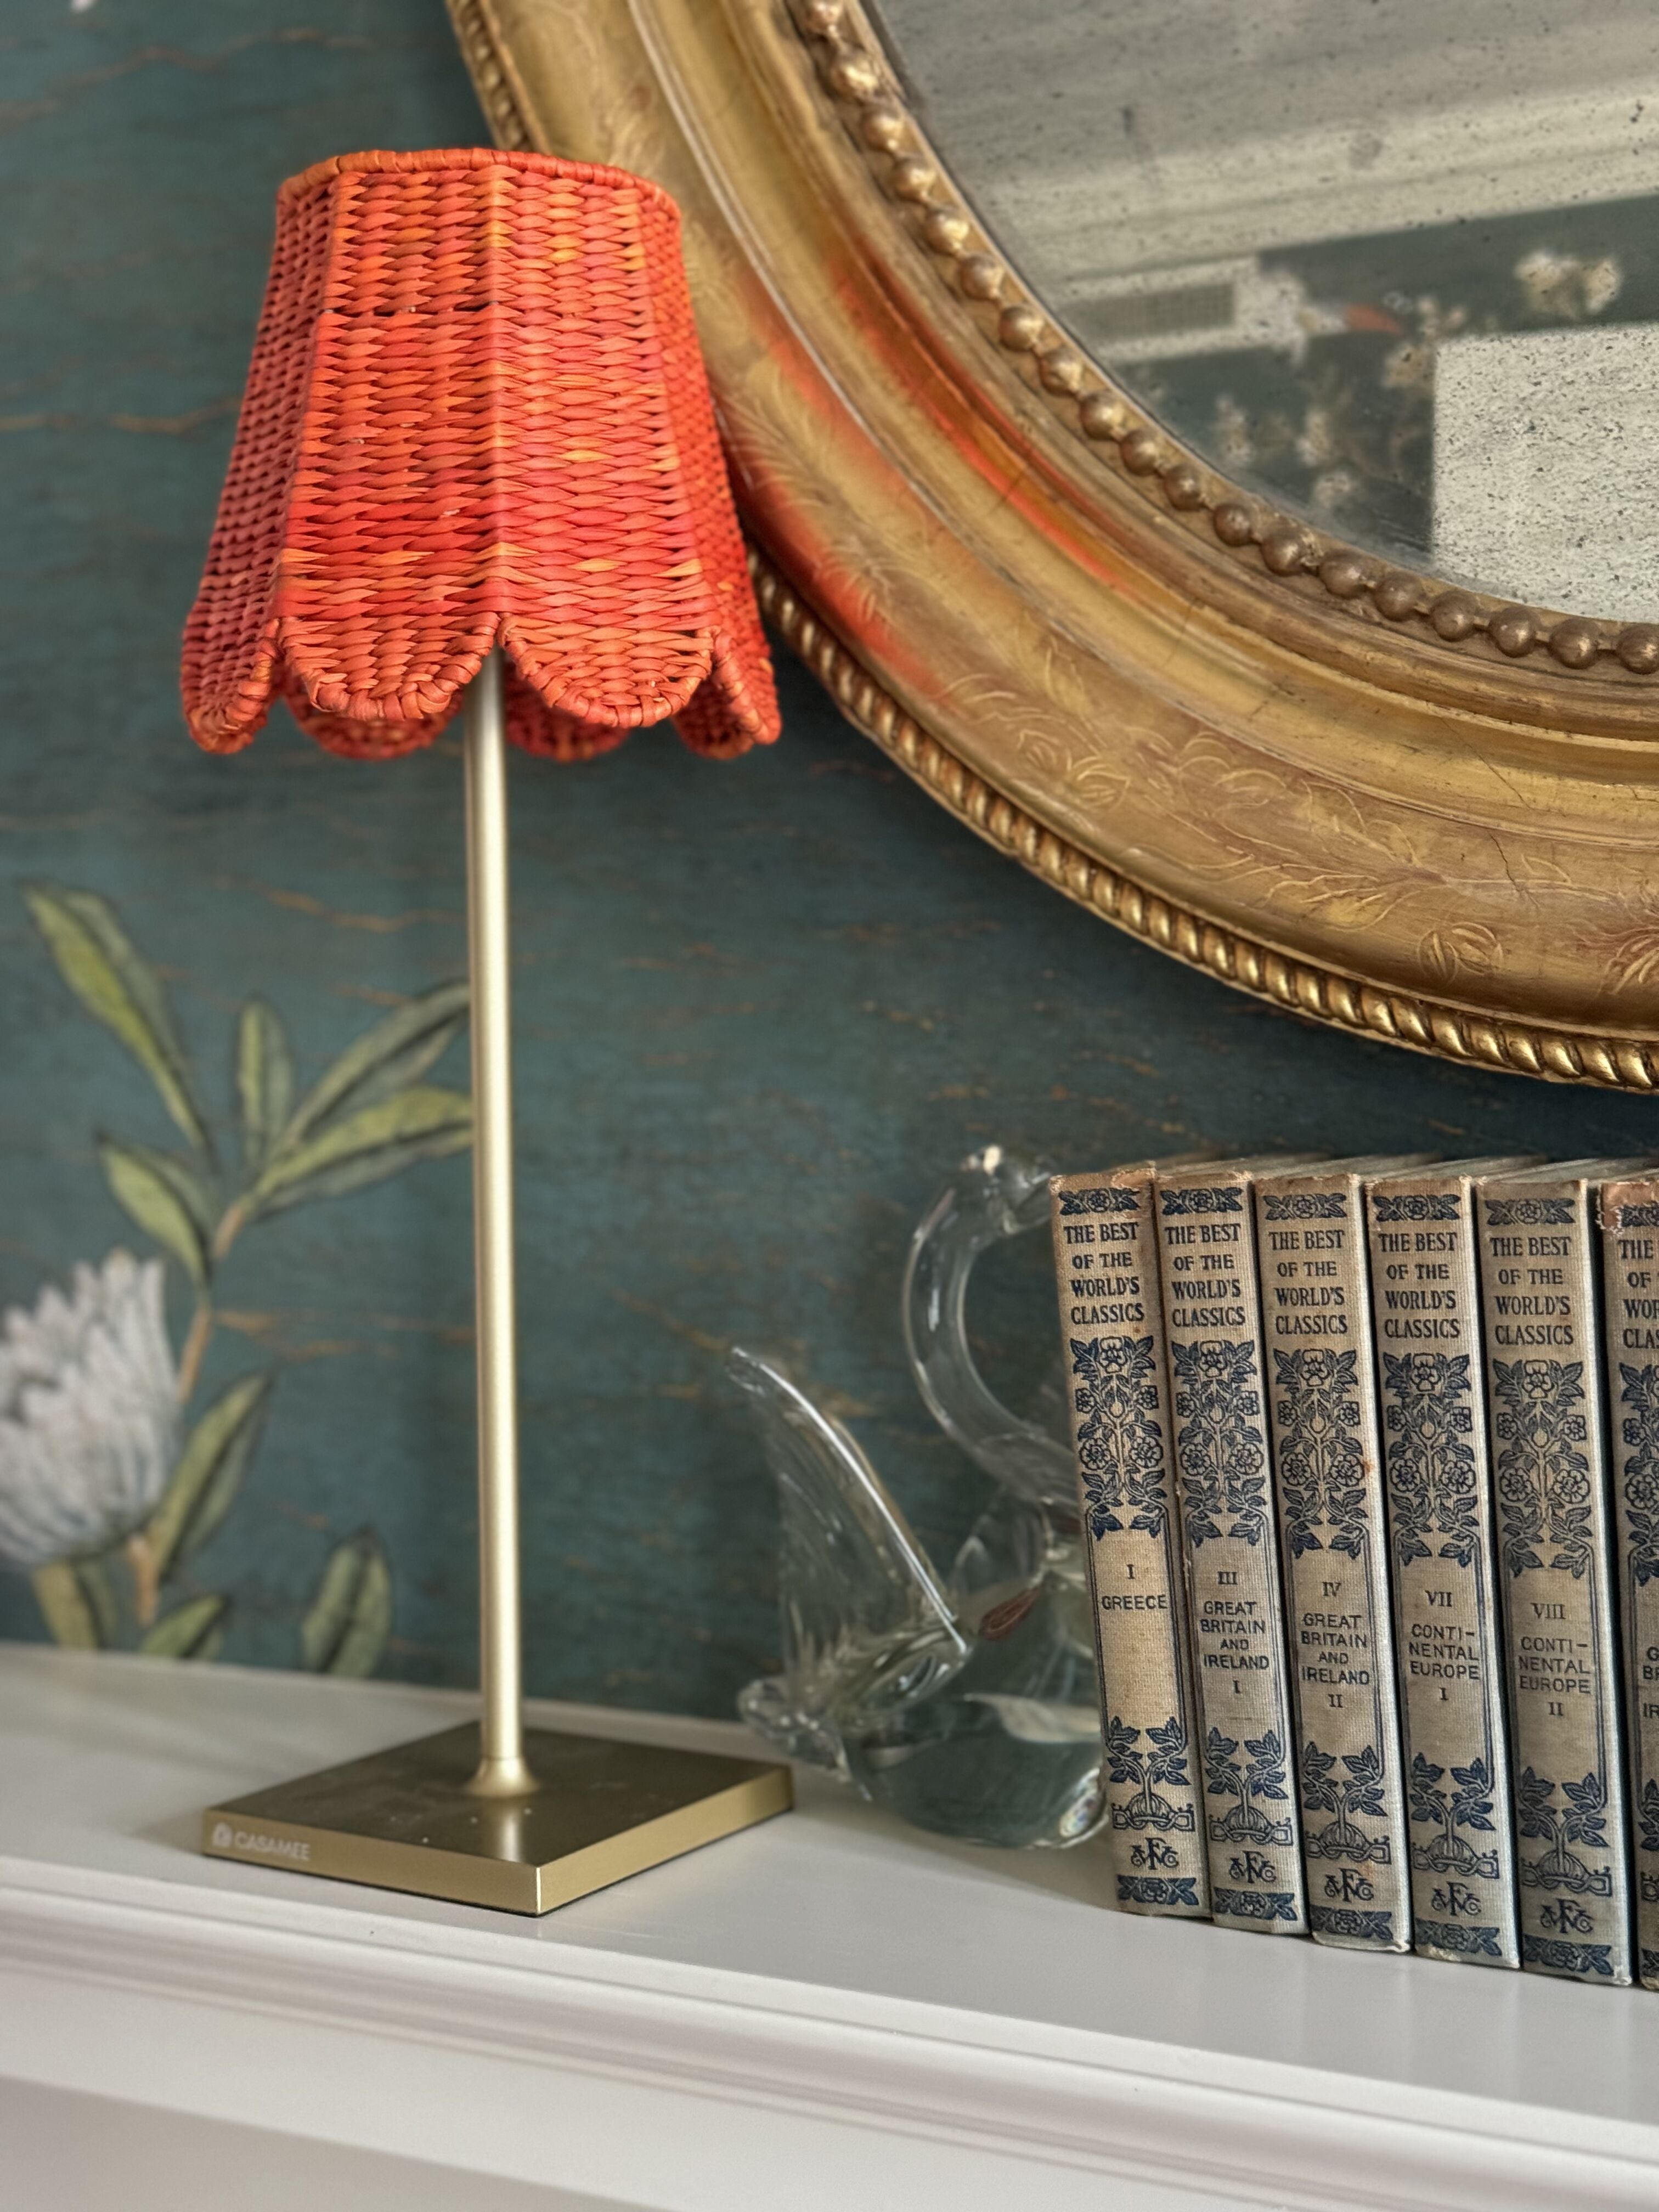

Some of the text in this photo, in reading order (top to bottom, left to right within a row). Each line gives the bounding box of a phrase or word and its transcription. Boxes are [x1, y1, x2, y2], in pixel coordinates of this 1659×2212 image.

[1063, 1222, 1139, 1244] THE BEST
[1165, 1223, 1242, 1244] THE BEST
[1268, 1230, 1344, 1250] THE BEST
[1378, 1232, 1458, 1252] THE BEST
[1489, 1237, 1572, 1256] THE BEST
[1617, 1239, 1654, 1259] THE
[1071, 1252, 1132, 1269] OF THE
[1173, 1254, 1234, 1271] OF THE
[1277, 1262, 1337, 1277] OF THE
[1386, 1265, 1449, 1280] OF THE
[1498, 1269, 1563, 1285] OF THE
[1070, 1277, 1139, 1297] WORLD'S
[1627, 1272, 1651, 1288] OF
[1171, 1279, 1241, 1300] WORLD'S
[1273, 1286, 1344, 1307] WORLD'S
[1384, 1290, 1456, 1310] WORLD'S
[1494, 1296, 1571, 1316] WORLD'S
[1070, 1303, 1144, 1325] CLASSICS
[1172, 1307, 1246, 1328] CLASSICS
[1275, 1315, 1348, 1335] CLASSICS
[1384, 1319, 1460, 1339] CLASSICS
[1494, 1325, 1573, 1345] CLASSICS
[1126, 1564, 1134, 1579] I
[1217, 1571, 1238, 1585] III
[1322, 1582, 1342, 1597] IV
[1101, 1595, 1169, 1610] GREECE
[1425, 1590, 1452, 1608] VII
[1204, 1601, 1257, 1616] GREAT
[1531, 1603, 1566, 1620] VIII
[1200, 1620, 1265, 1634] BRITAIN
[1303, 1614, 1362, 1629] GREAT
[1301, 1632, 1367, 1647] BRITAIN
[1411, 1624, 1475, 1641] CONTI-
[1220, 1639, 1249, 1650] AND
[1408, 1643, 1479, 1661] NENTAL
[1521, 1637, 1588, 1654] CONTI-
[1203, 1655, 1269, 1670] IRELAND
[1318, 1652, 1348, 1664] AND
[1517, 1656, 1590, 1674] NENTAL
[1302, 1667, 1369, 1685] IRELAND
[1410, 1661, 1479, 1680] EUROPE
[1233, 1680, 1240, 1694] I
[1520, 1676, 1591, 1694] EUROPE
[1328, 1694, 1344, 1708] II
[1439, 1688, 1449, 1701] I
[1549, 1702, 1564, 1717] II
